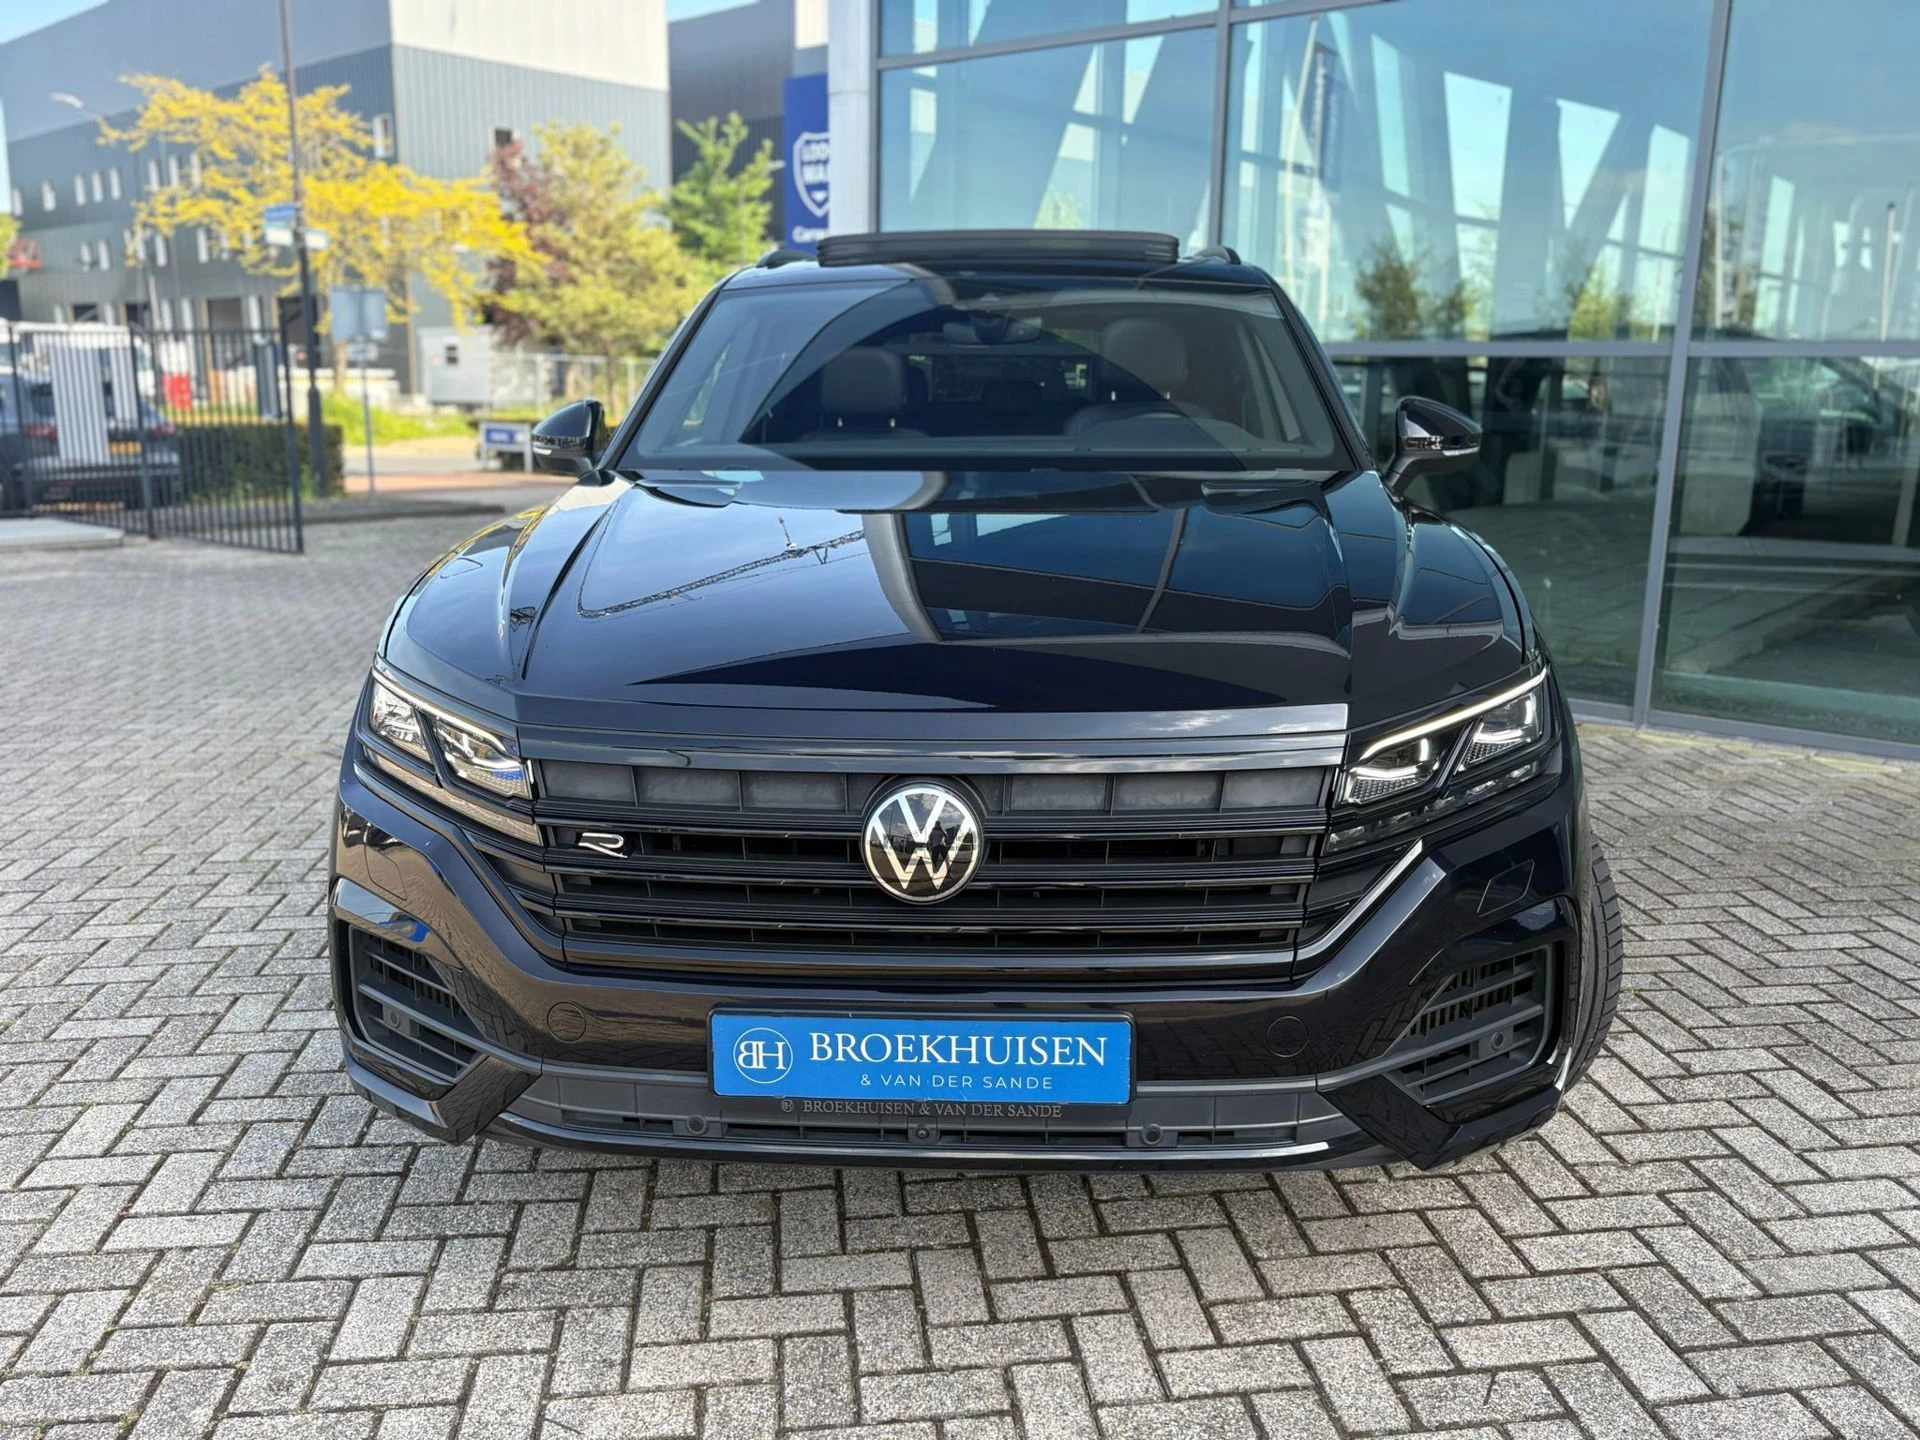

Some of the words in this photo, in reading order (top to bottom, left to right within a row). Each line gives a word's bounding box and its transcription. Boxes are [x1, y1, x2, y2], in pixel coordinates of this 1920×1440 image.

[809, 1031, 1108, 1067] BROEKHUISEN
[860, 1073, 872, 1086] &
[880, 1074, 921, 1088] VAN
[932, 1075, 973, 1088] DER
[983, 1076, 1053, 1090] SANDE
[803, 1101, 915, 1116] BROEKHUISEN
[919, 1102, 931, 1115] &
[935, 1103, 966, 1116] VAN
[971, 1104, 1005, 1117] DER
[1007, 1104, 1063, 1118] SANDE
